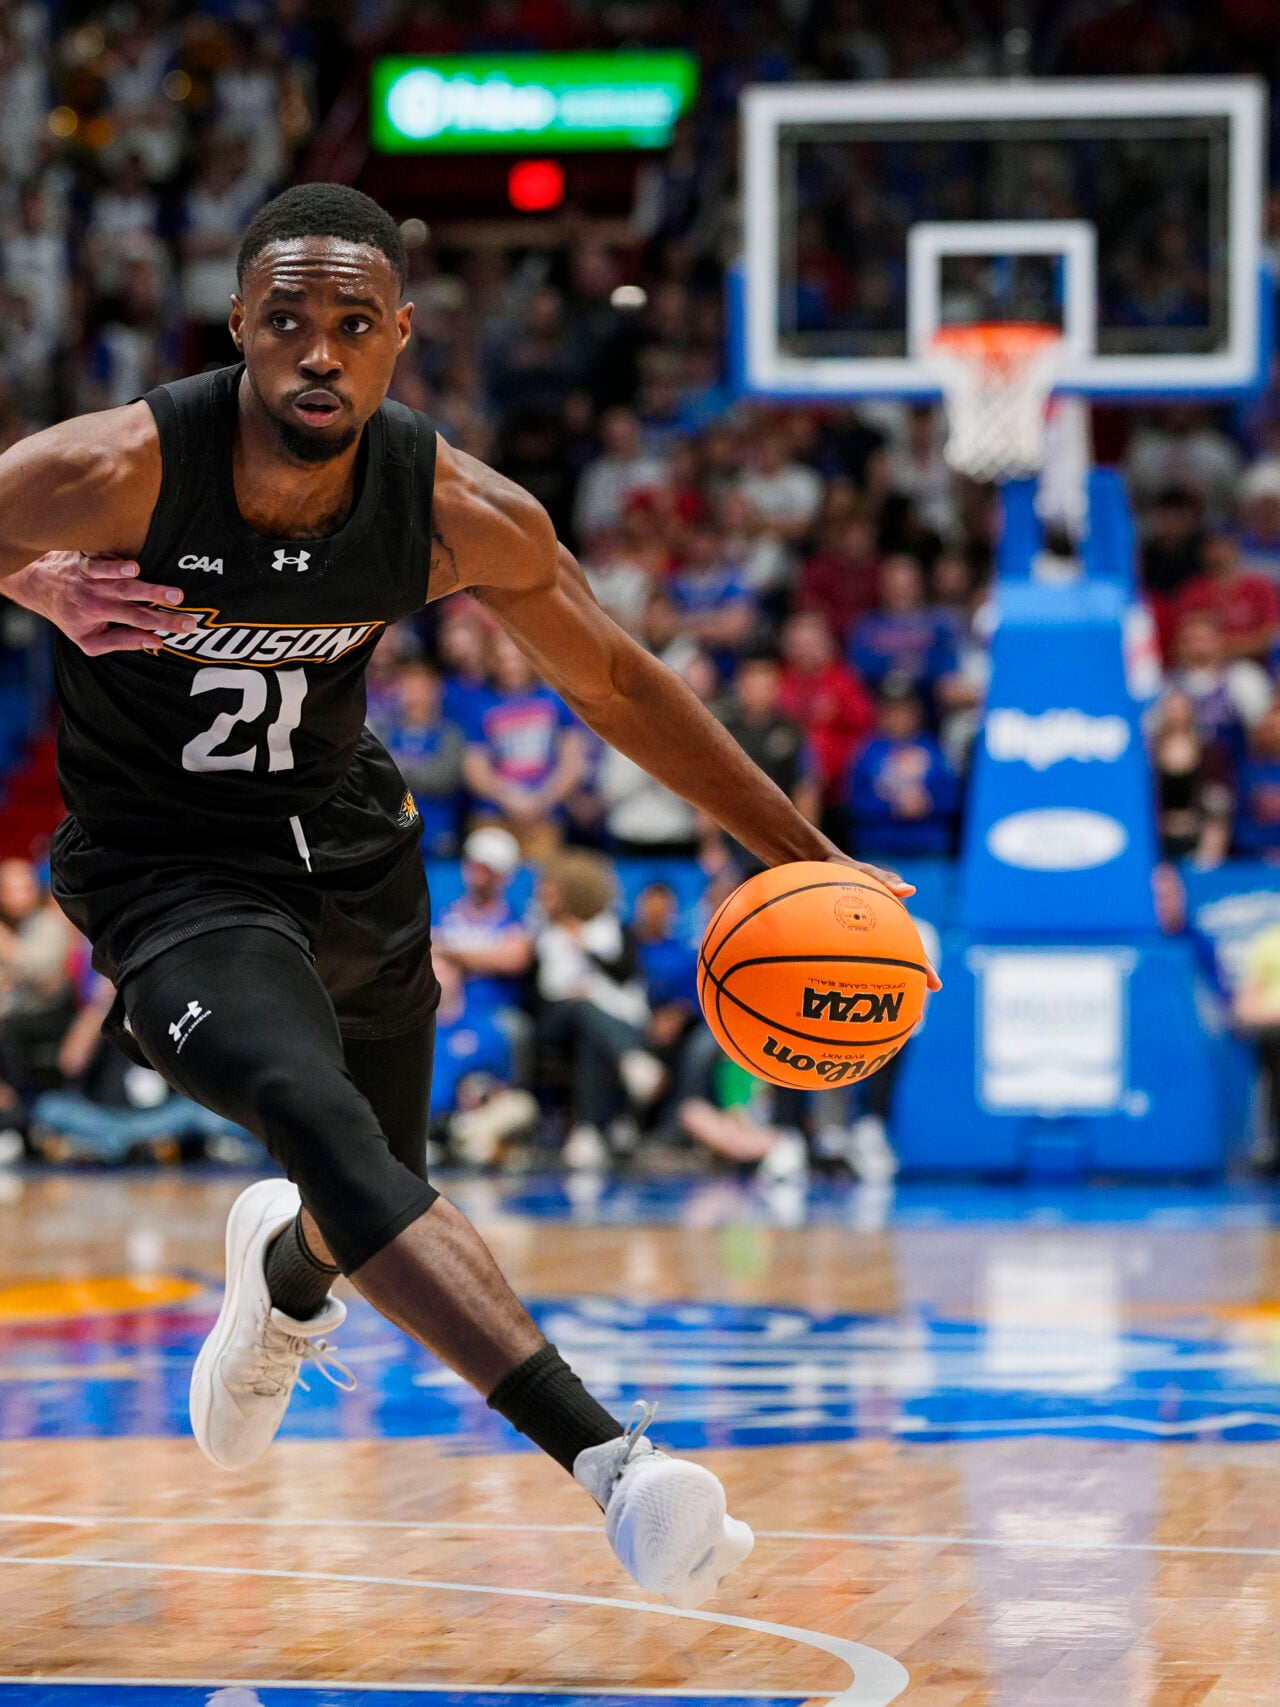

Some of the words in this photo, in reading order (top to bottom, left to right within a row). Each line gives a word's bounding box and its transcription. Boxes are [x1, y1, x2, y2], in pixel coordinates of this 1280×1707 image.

[178, 554, 223, 575] CAA
[153, 608, 370, 662] OWSON
[181, 667, 308, 773] 21
[808, 978, 836, 987] BALL
[838, 982, 868, 990] GAME
[871, 982, 906, 990] OFFICIAL
[802, 986, 905, 1023] NCAA
[762, 1035, 899, 1082] Wilson
